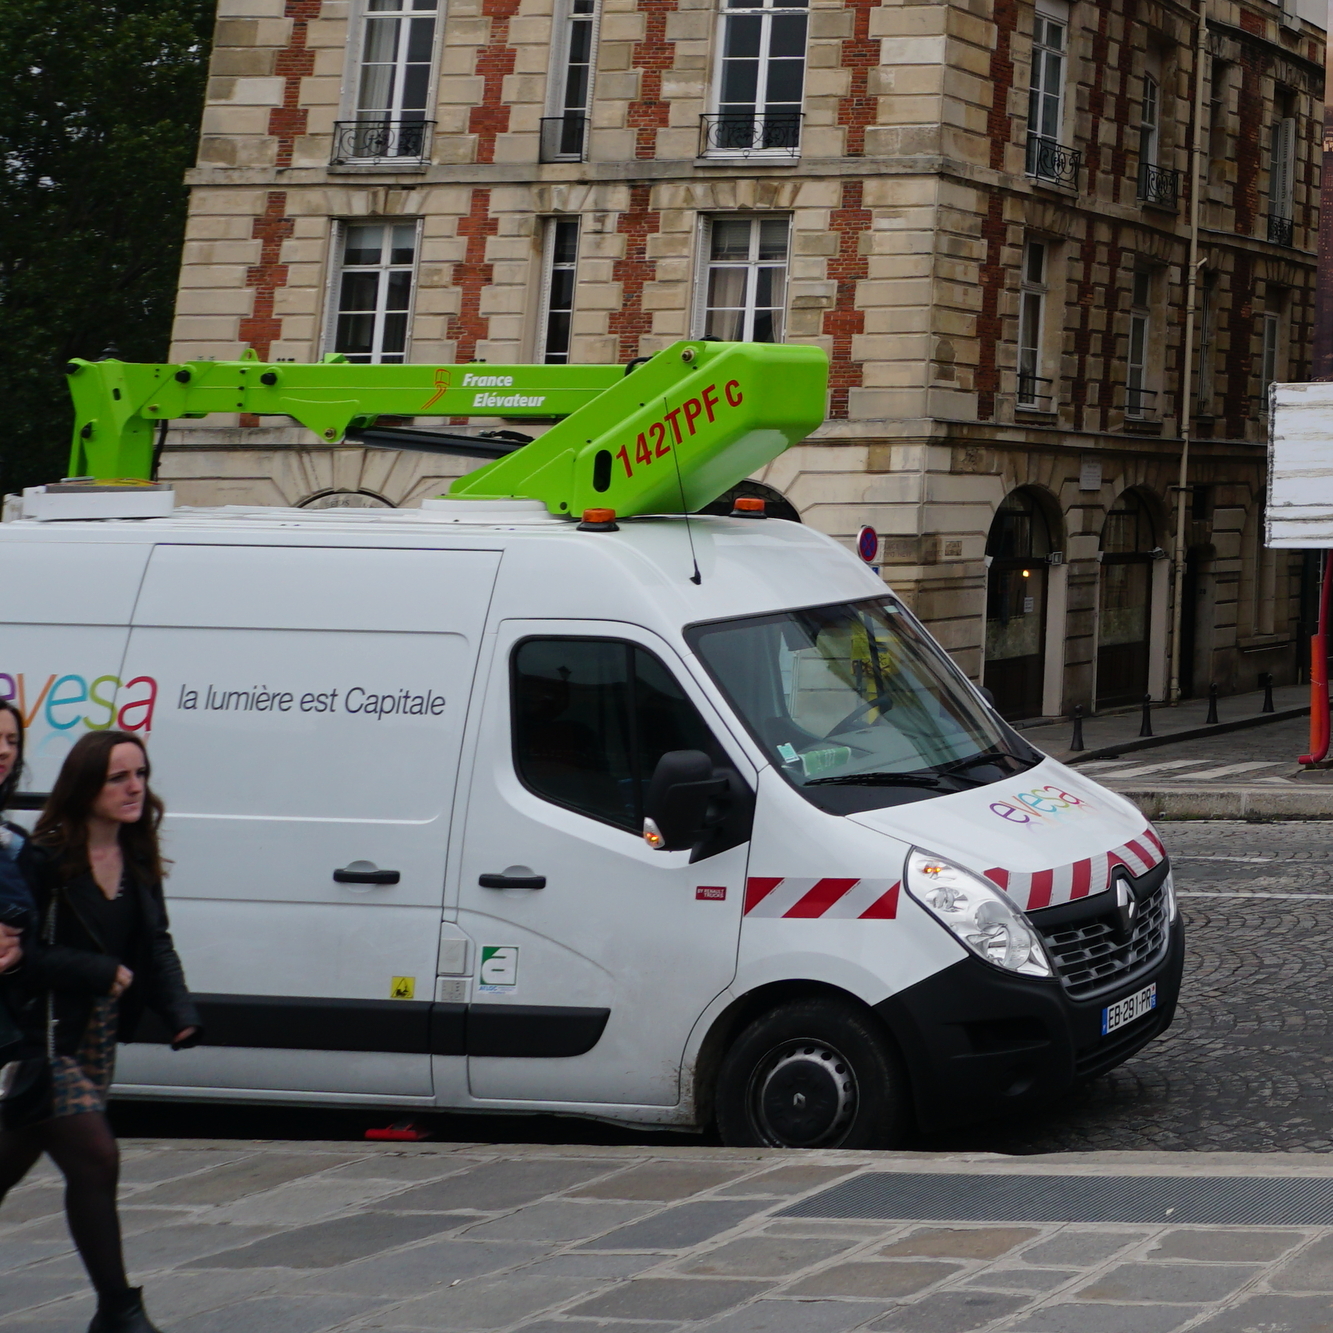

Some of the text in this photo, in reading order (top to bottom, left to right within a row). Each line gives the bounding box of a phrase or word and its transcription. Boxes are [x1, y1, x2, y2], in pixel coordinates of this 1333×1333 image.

[462, 373, 513, 387] France
[473, 392, 545, 408] Elévateur
[177, 684, 446, 720] la lumière est Capitale
[989, 785, 1085, 823] evesa
[1108, 988, 1152, 1029] EB-291-PR
